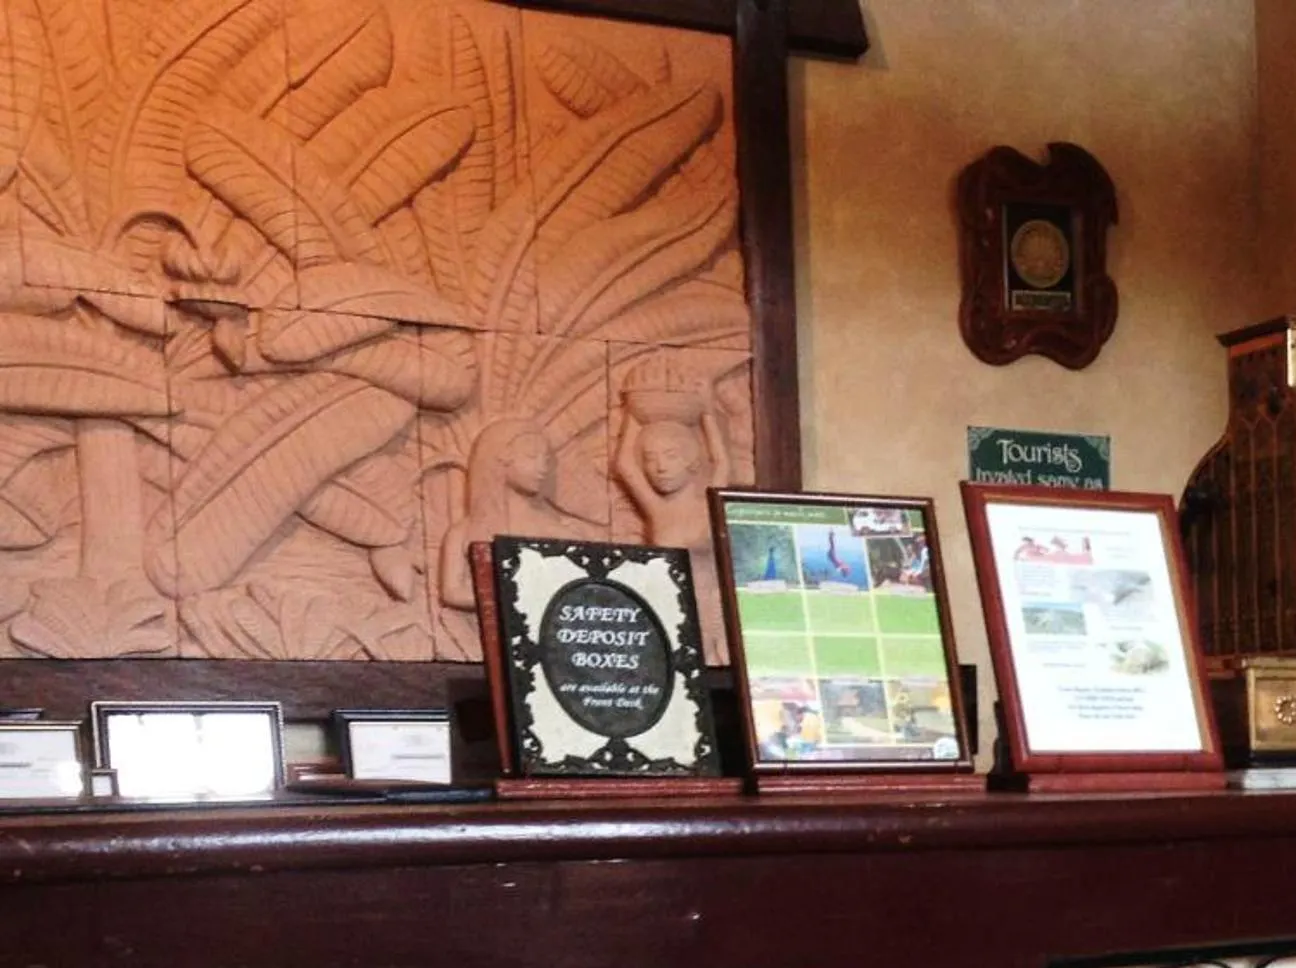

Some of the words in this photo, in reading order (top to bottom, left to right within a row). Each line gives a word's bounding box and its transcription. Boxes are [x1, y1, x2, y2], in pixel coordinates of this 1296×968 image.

[996, 439, 1083, 473] Tourists
[559, 605, 642, 622] SAFETY
[556, 628, 650, 646] DEPOSIT
[571, 652, 639, 669] BOXES
